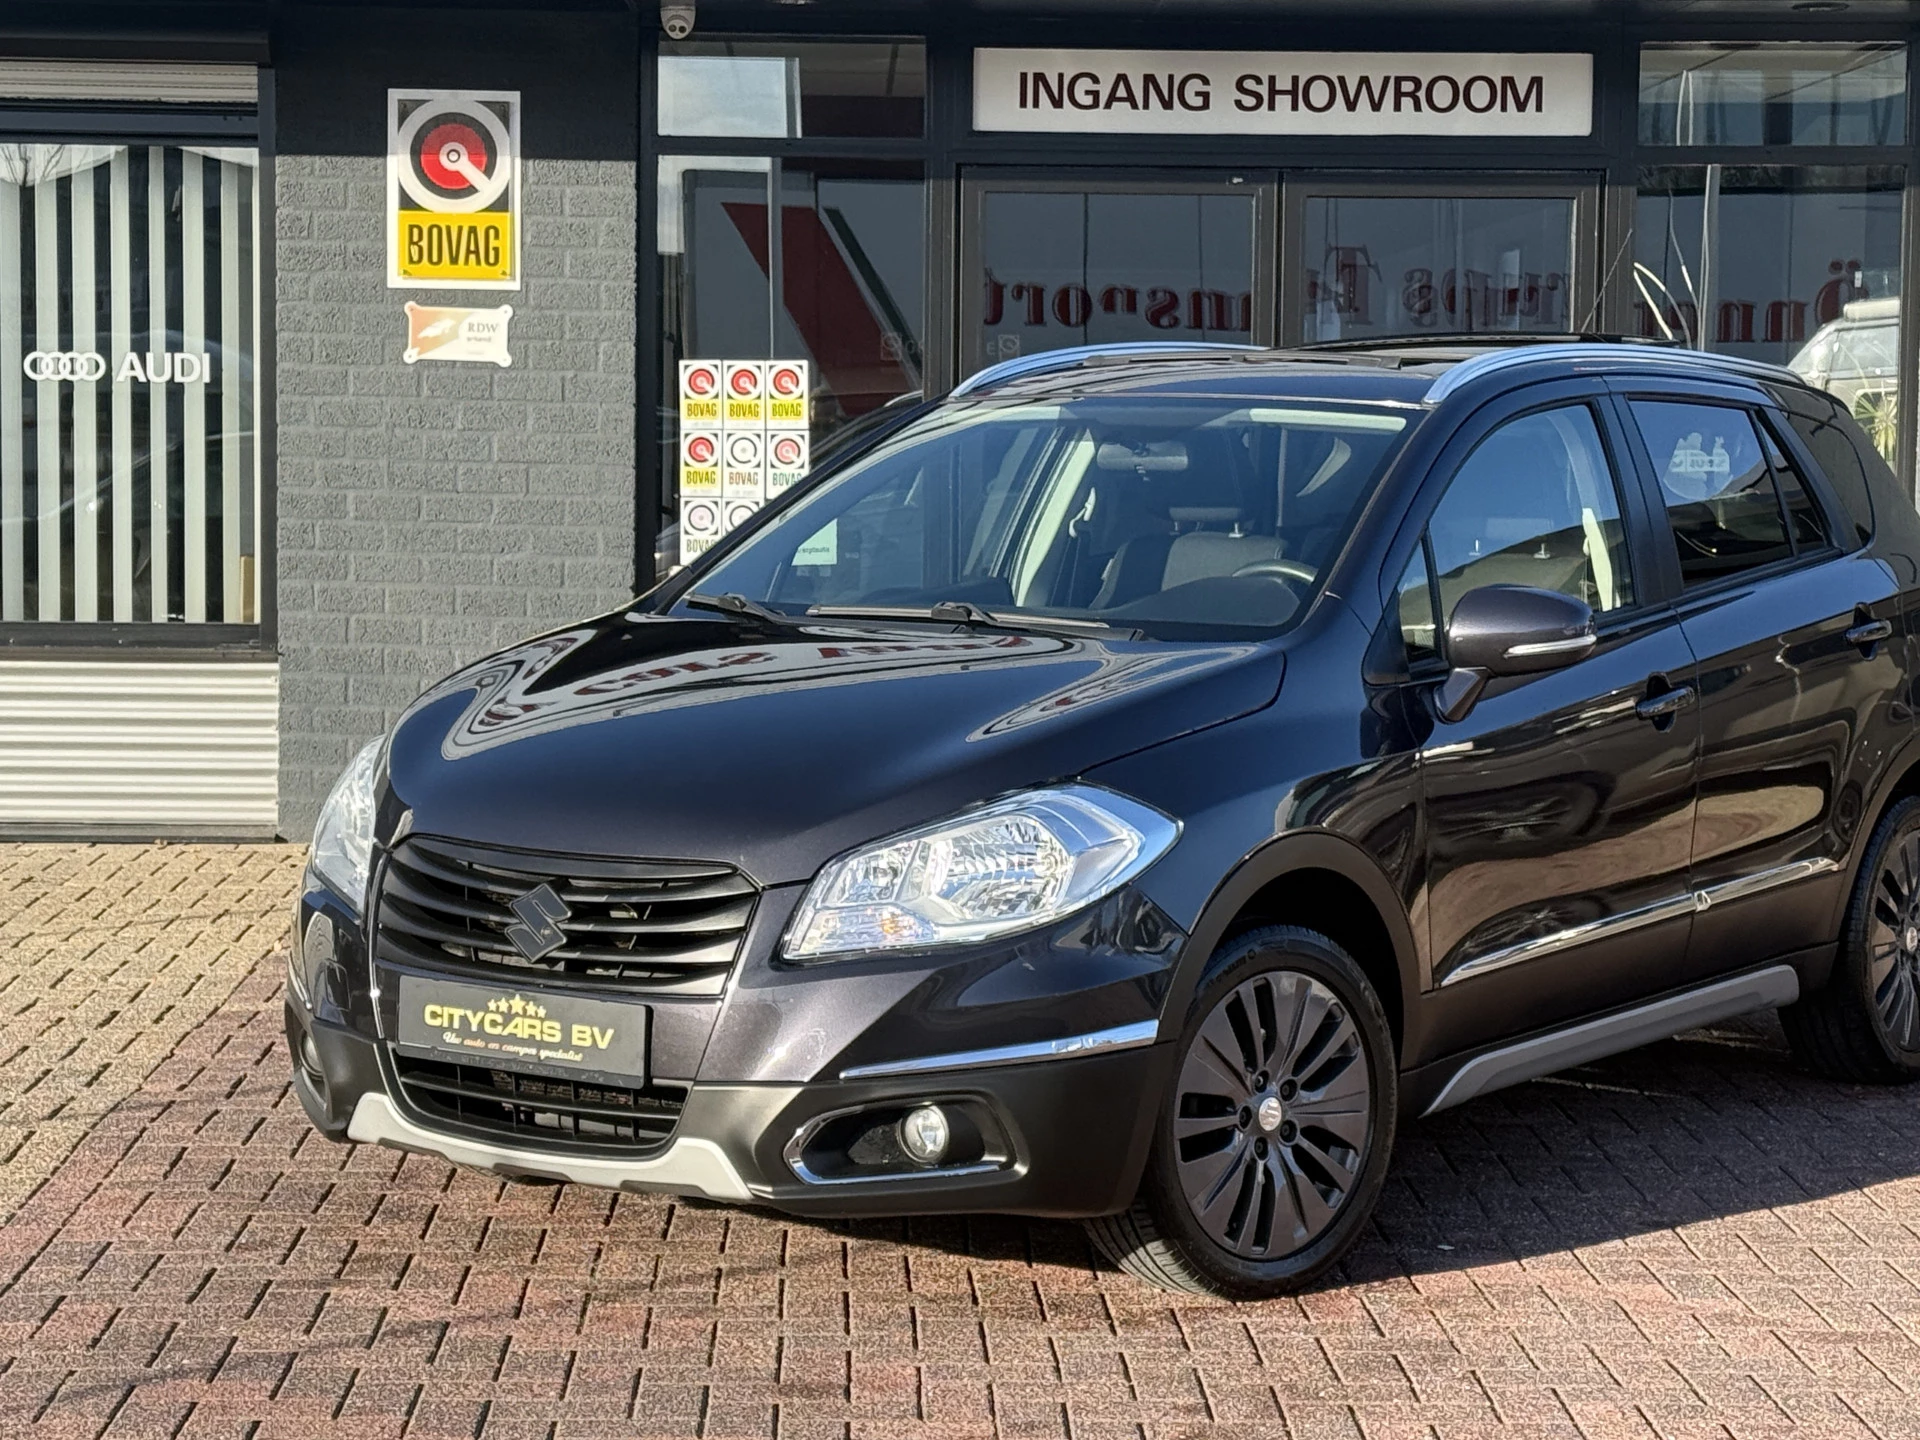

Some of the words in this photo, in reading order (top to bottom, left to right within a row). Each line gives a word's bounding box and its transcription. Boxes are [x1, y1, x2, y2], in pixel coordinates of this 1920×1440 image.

[1018, 72, 1211, 111] INGANG
[1233, 74, 1543, 113] SHOWROOM
[407, 223, 500, 267] BOVAG
[468, 322, 499, 333] RDW
[116, 352, 211, 383] AUDI
[686, 403, 717, 417] BOVAG
[729, 403, 760, 417] BOVAG
[772, 403, 802, 417] BOVAG
[686, 471, 716, 485] BOVAG
[729, 472, 759, 486] BOVAG
[424, 1004, 561, 1043] CITYCARS
[571, 1024, 614, 1050] BV
[463, 1038, 486, 1049] auto
